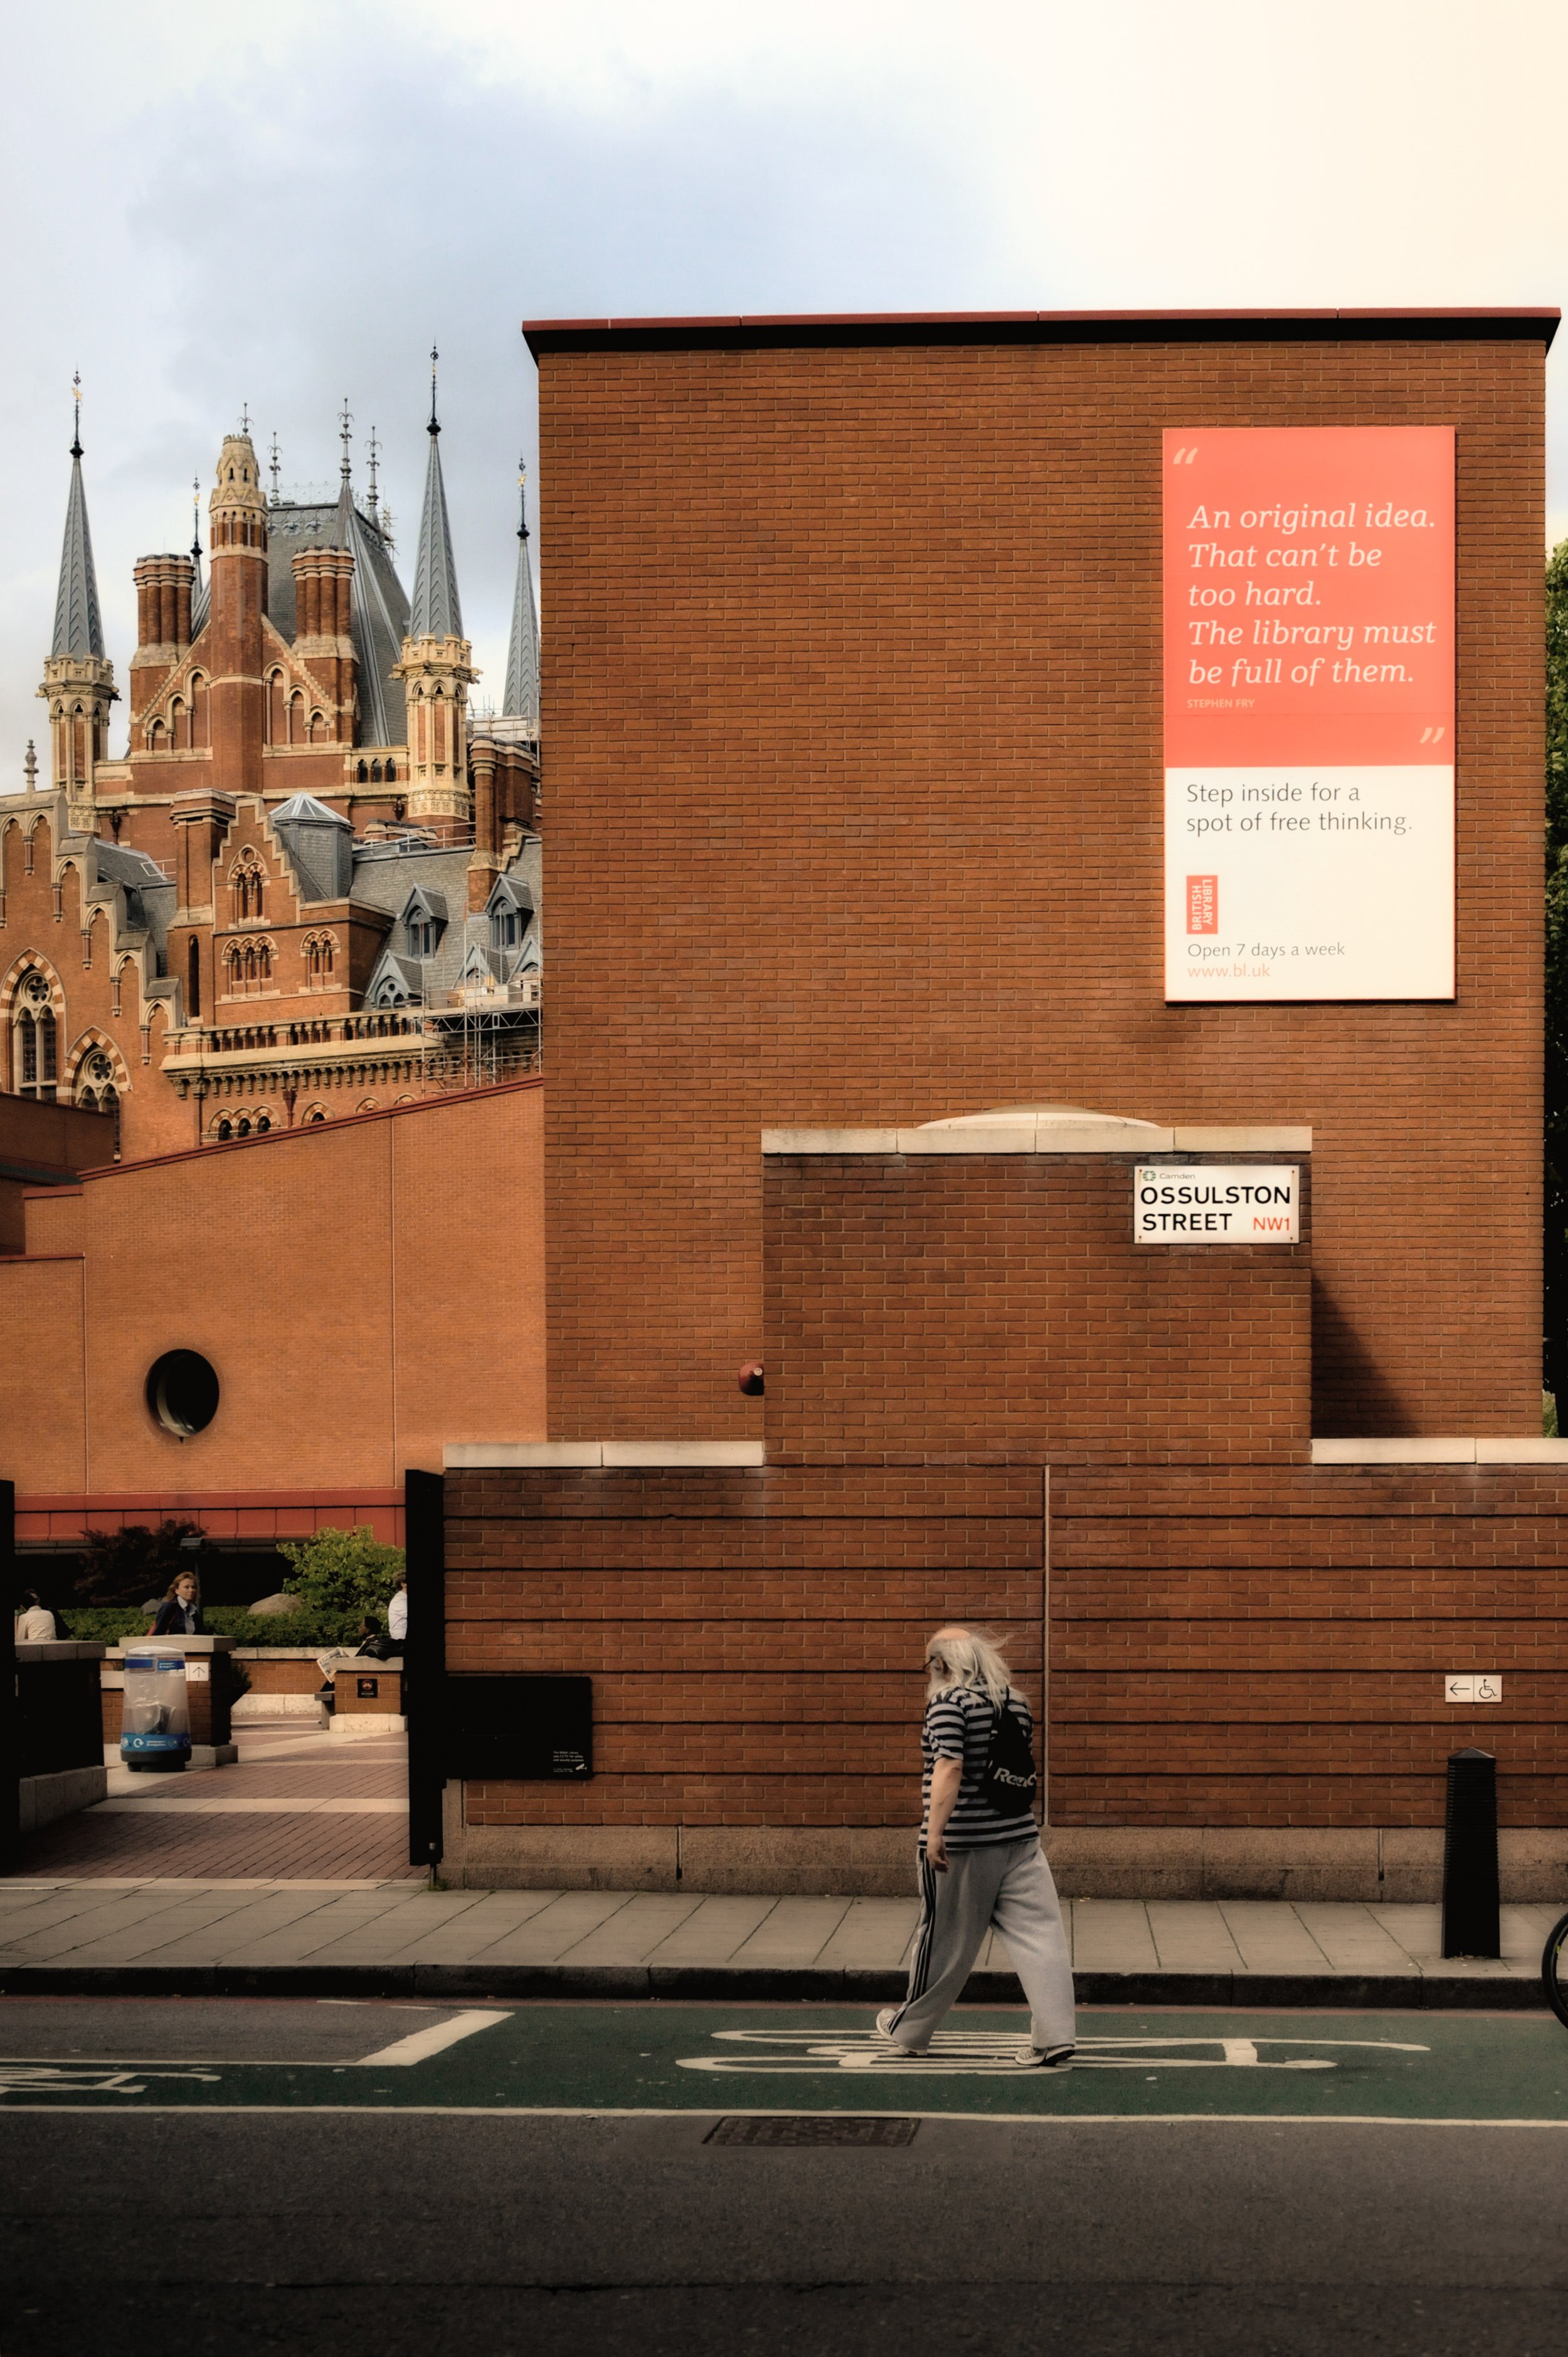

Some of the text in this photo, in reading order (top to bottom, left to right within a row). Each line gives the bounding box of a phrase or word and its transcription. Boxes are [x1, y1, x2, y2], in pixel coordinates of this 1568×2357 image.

[1186, 502, 1434, 535] An original idea.
[1189, 542, 1258, 568] That
[1348, 541, 1382, 567] be
[1189, 580, 1321, 607] too hard.
[1189, 619, 1437, 651] The library must
[1189, 657, 1413, 687] be full of them.
[1187, 698, 1255, 708] STEPHEN FRY
[1187, 782, 1360, 808] Step inside for a
[1187, 811, 1412, 838] spot of free thinking.
[1191, 885, 1202, 931] BRITISH
[1202, 878, 1213, 926] LIBRARY
[1187, 942, 1345, 960] Open 7 days a week
[1187, 963, 1270, 977] www.bl.uk
[1140, 1186, 1290, 1205] OSSULSTON
[1142, 1213, 1290, 1231] STREET NW1
